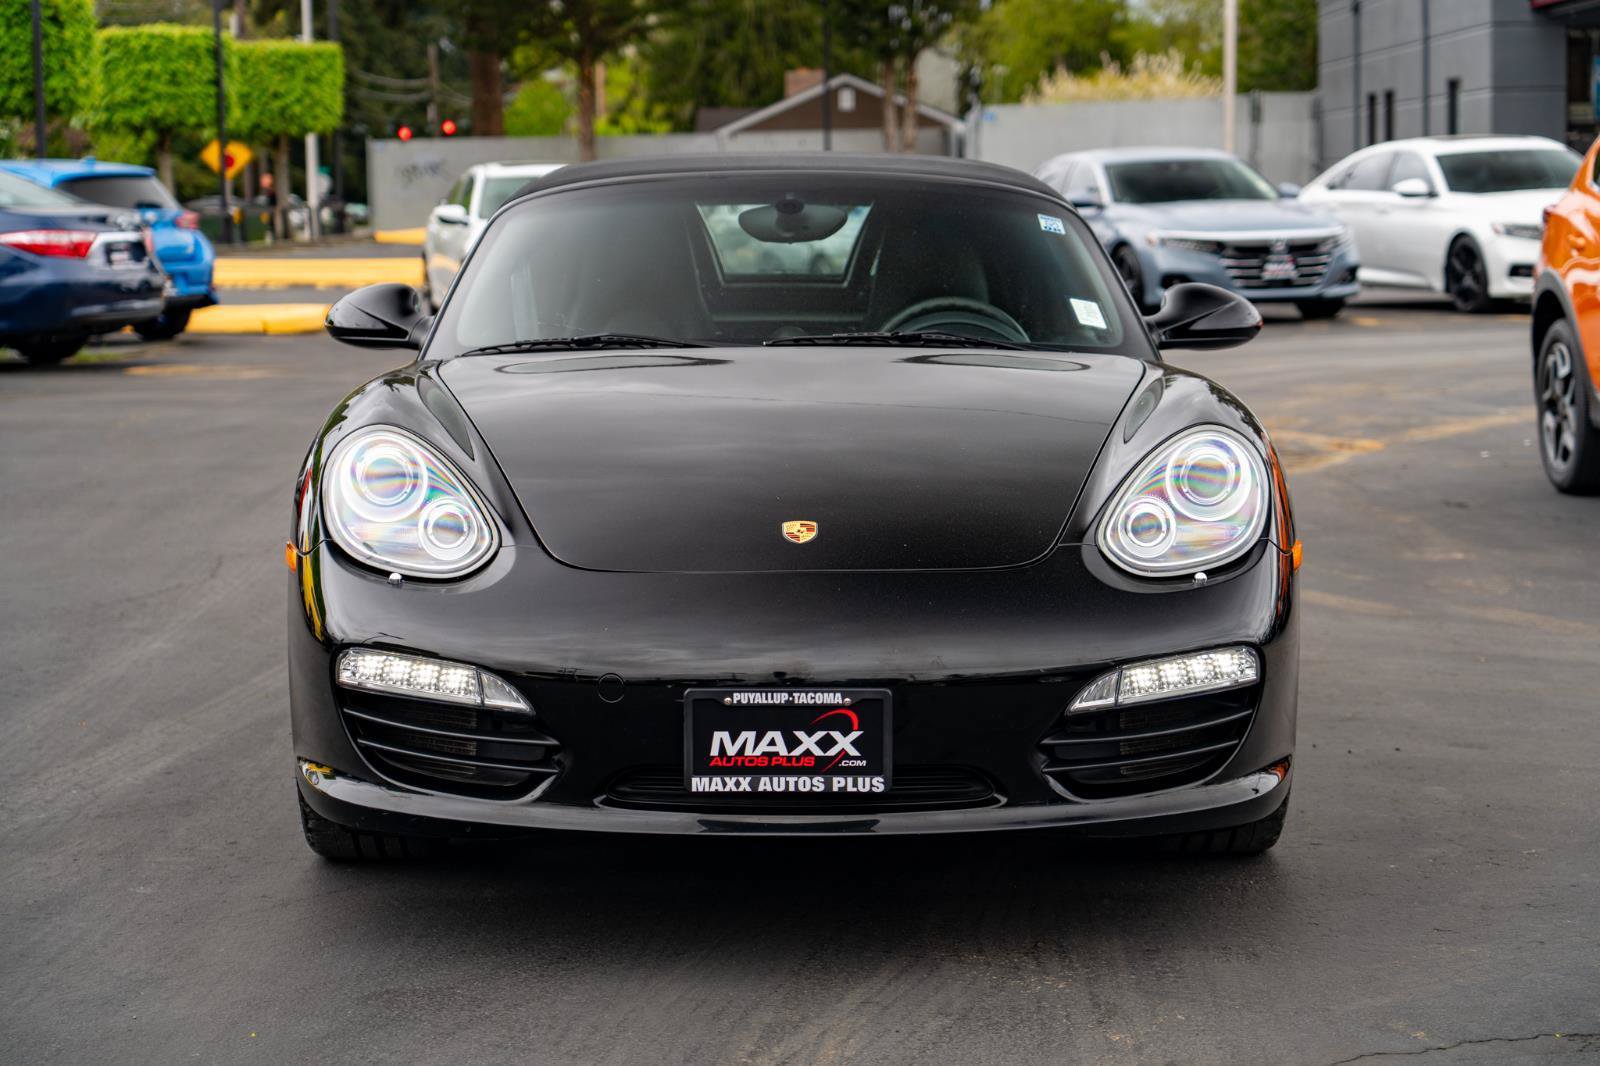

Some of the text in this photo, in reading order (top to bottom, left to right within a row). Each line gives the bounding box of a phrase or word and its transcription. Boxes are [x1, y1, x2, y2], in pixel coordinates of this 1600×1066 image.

[709, 730, 865, 757] MAXX
[709, 756, 816, 767] AUTOS PLUS
[838, 759, 867, 767] .COM
[691, 776, 885, 793] MAXX AUTOS PLUS
